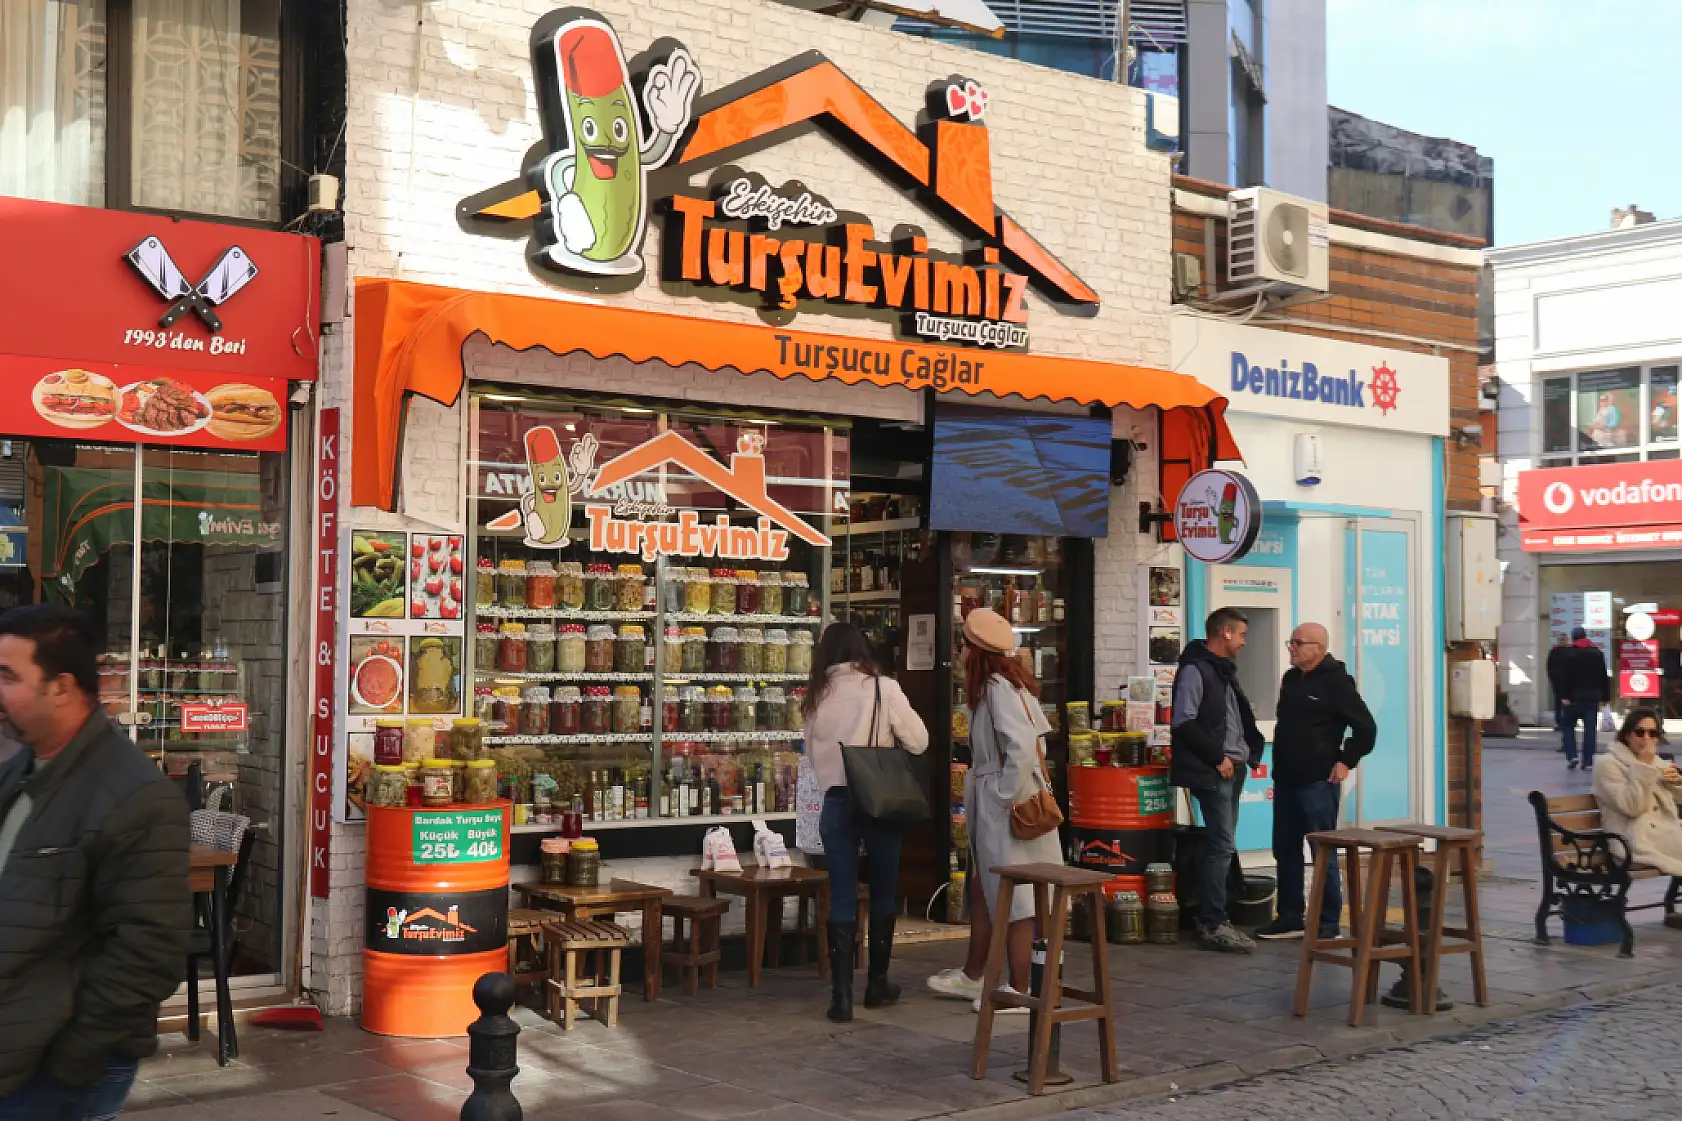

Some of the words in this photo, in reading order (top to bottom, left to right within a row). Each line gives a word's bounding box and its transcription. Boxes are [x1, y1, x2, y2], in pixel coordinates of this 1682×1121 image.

[722, 178, 838, 231] Eskişehir
[672, 194, 1029, 323] TurşuEvimiz
[123, 329, 204, 352] 1993'den
[209, 336, 246, 356] Beri
[915, 312, 978, 341] Turşucu
[979, 321, 1028, 348] Çağlar
[775, 335, 890, 378] Turşucu
[901, 349, 985, 389] Çağlar
[1231, 351, 1365, 407] DenizBank
[320, 434, 336, 612] KÖFTE
[586, 507, 790, 563] TurşuEvimiz
[1181, 521, 1217, 538] Evimiz
[1352, 602, 1400, 620] RTAK
[1352, 624, 1400, 646] TM'Sİ
[318, 641, 331, 666] &
[315, 697, 330, 869] SUCUK
[420, 830, 458, 841] Küçük
[467, 828, 497, 840] Büyük
[456, 815, 482, 825] Turşu
